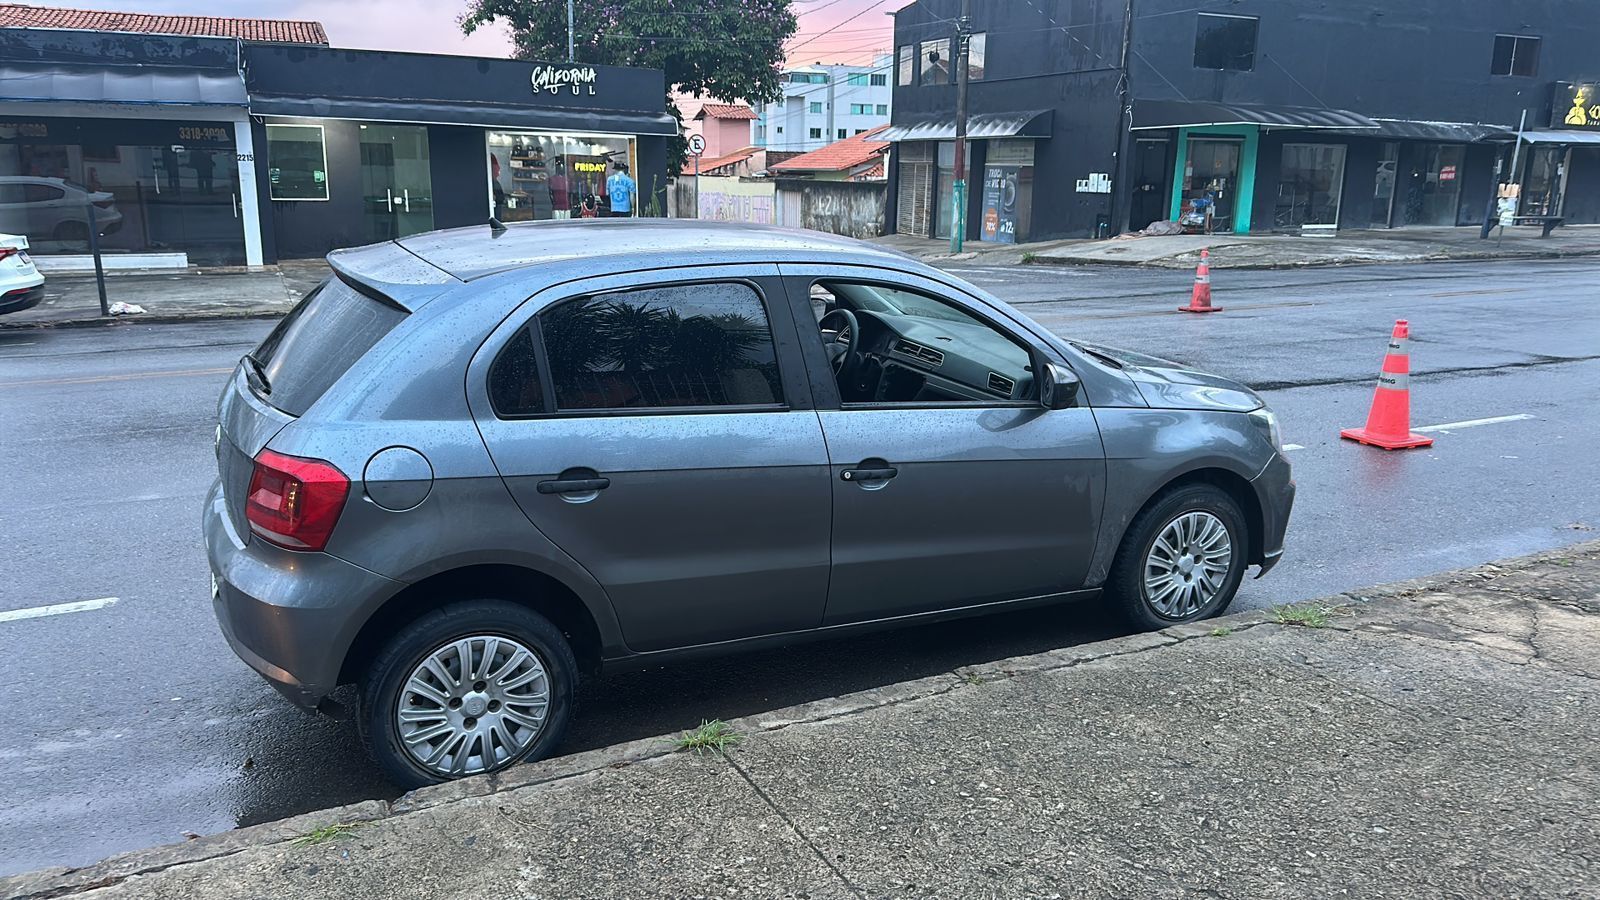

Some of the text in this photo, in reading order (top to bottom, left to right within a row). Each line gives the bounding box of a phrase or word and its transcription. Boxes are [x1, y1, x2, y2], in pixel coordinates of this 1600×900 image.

[532, 85, 596, 95] SOUL
[237, 154, 254, 162] 2215
[574, 162, 607, 172] FRIDAY
